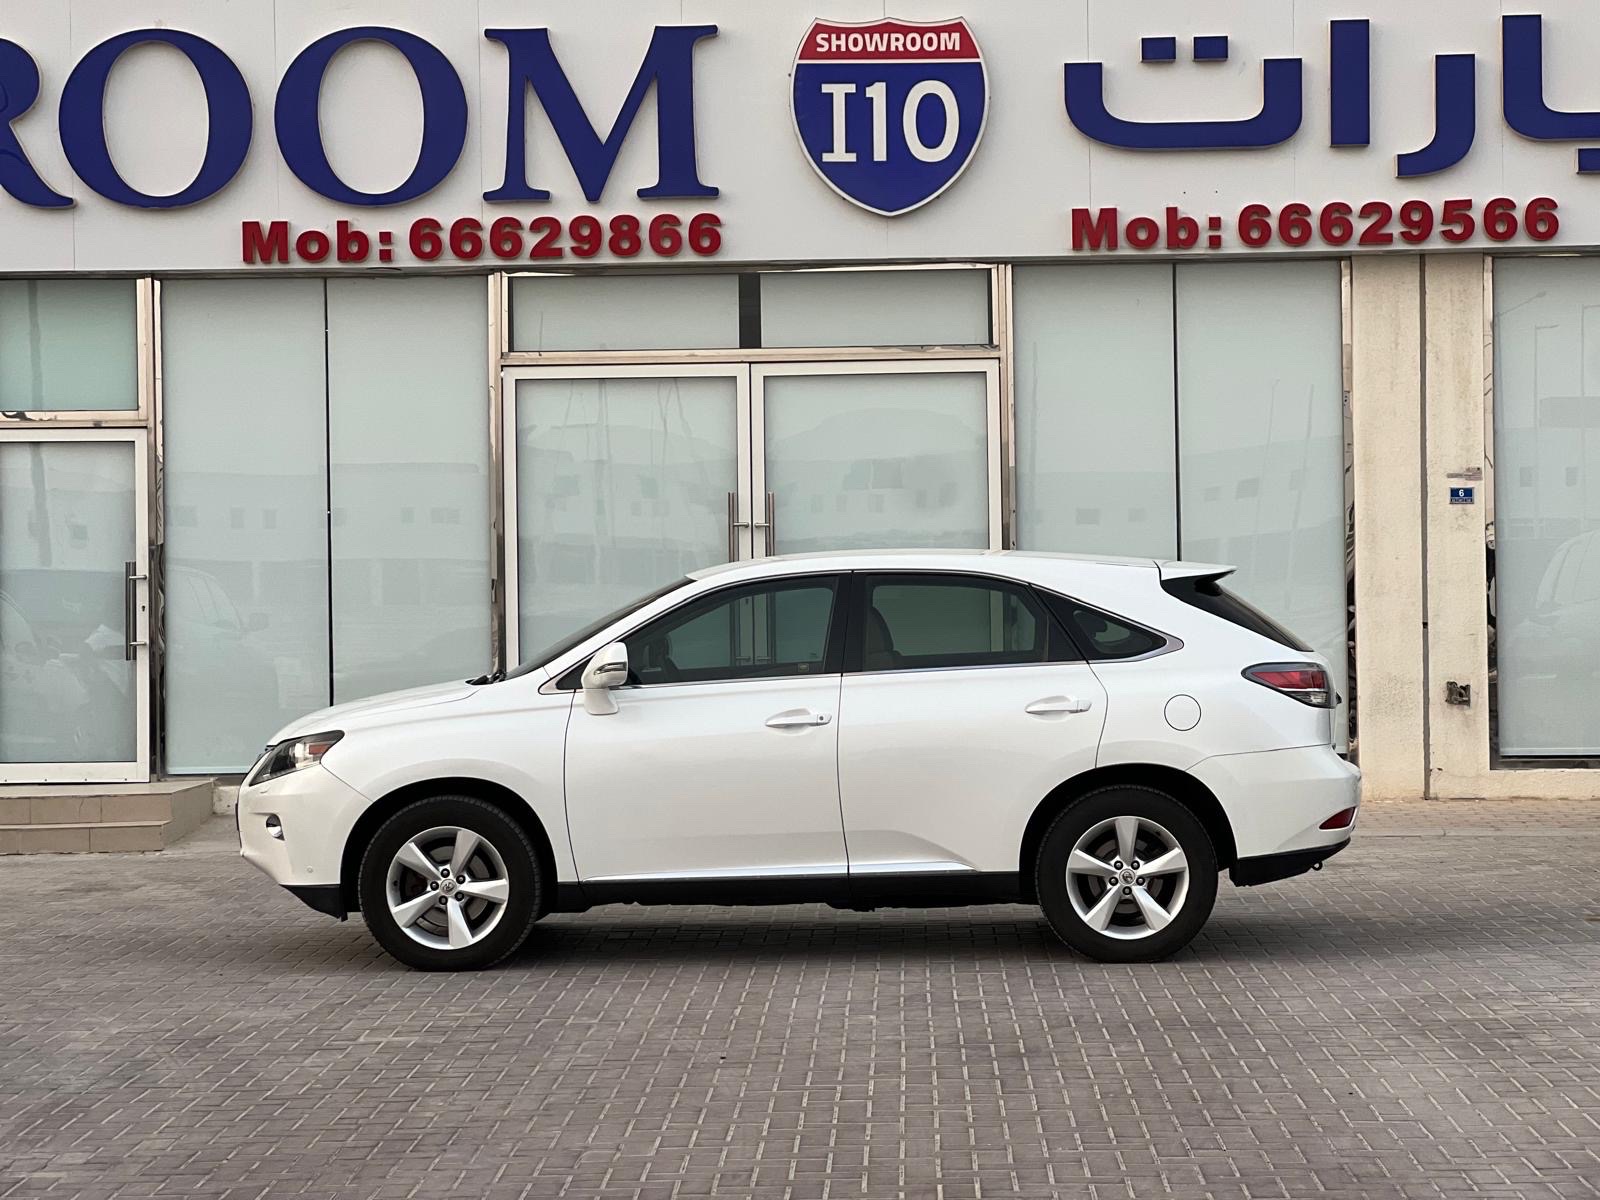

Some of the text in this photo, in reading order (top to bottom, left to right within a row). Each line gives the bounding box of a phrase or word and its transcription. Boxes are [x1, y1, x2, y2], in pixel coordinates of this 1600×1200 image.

[815, 32, 961, 52] SHOWROOM
[821, 79, 960, 163] I10
[1458, 489, 1465, 497] 6
